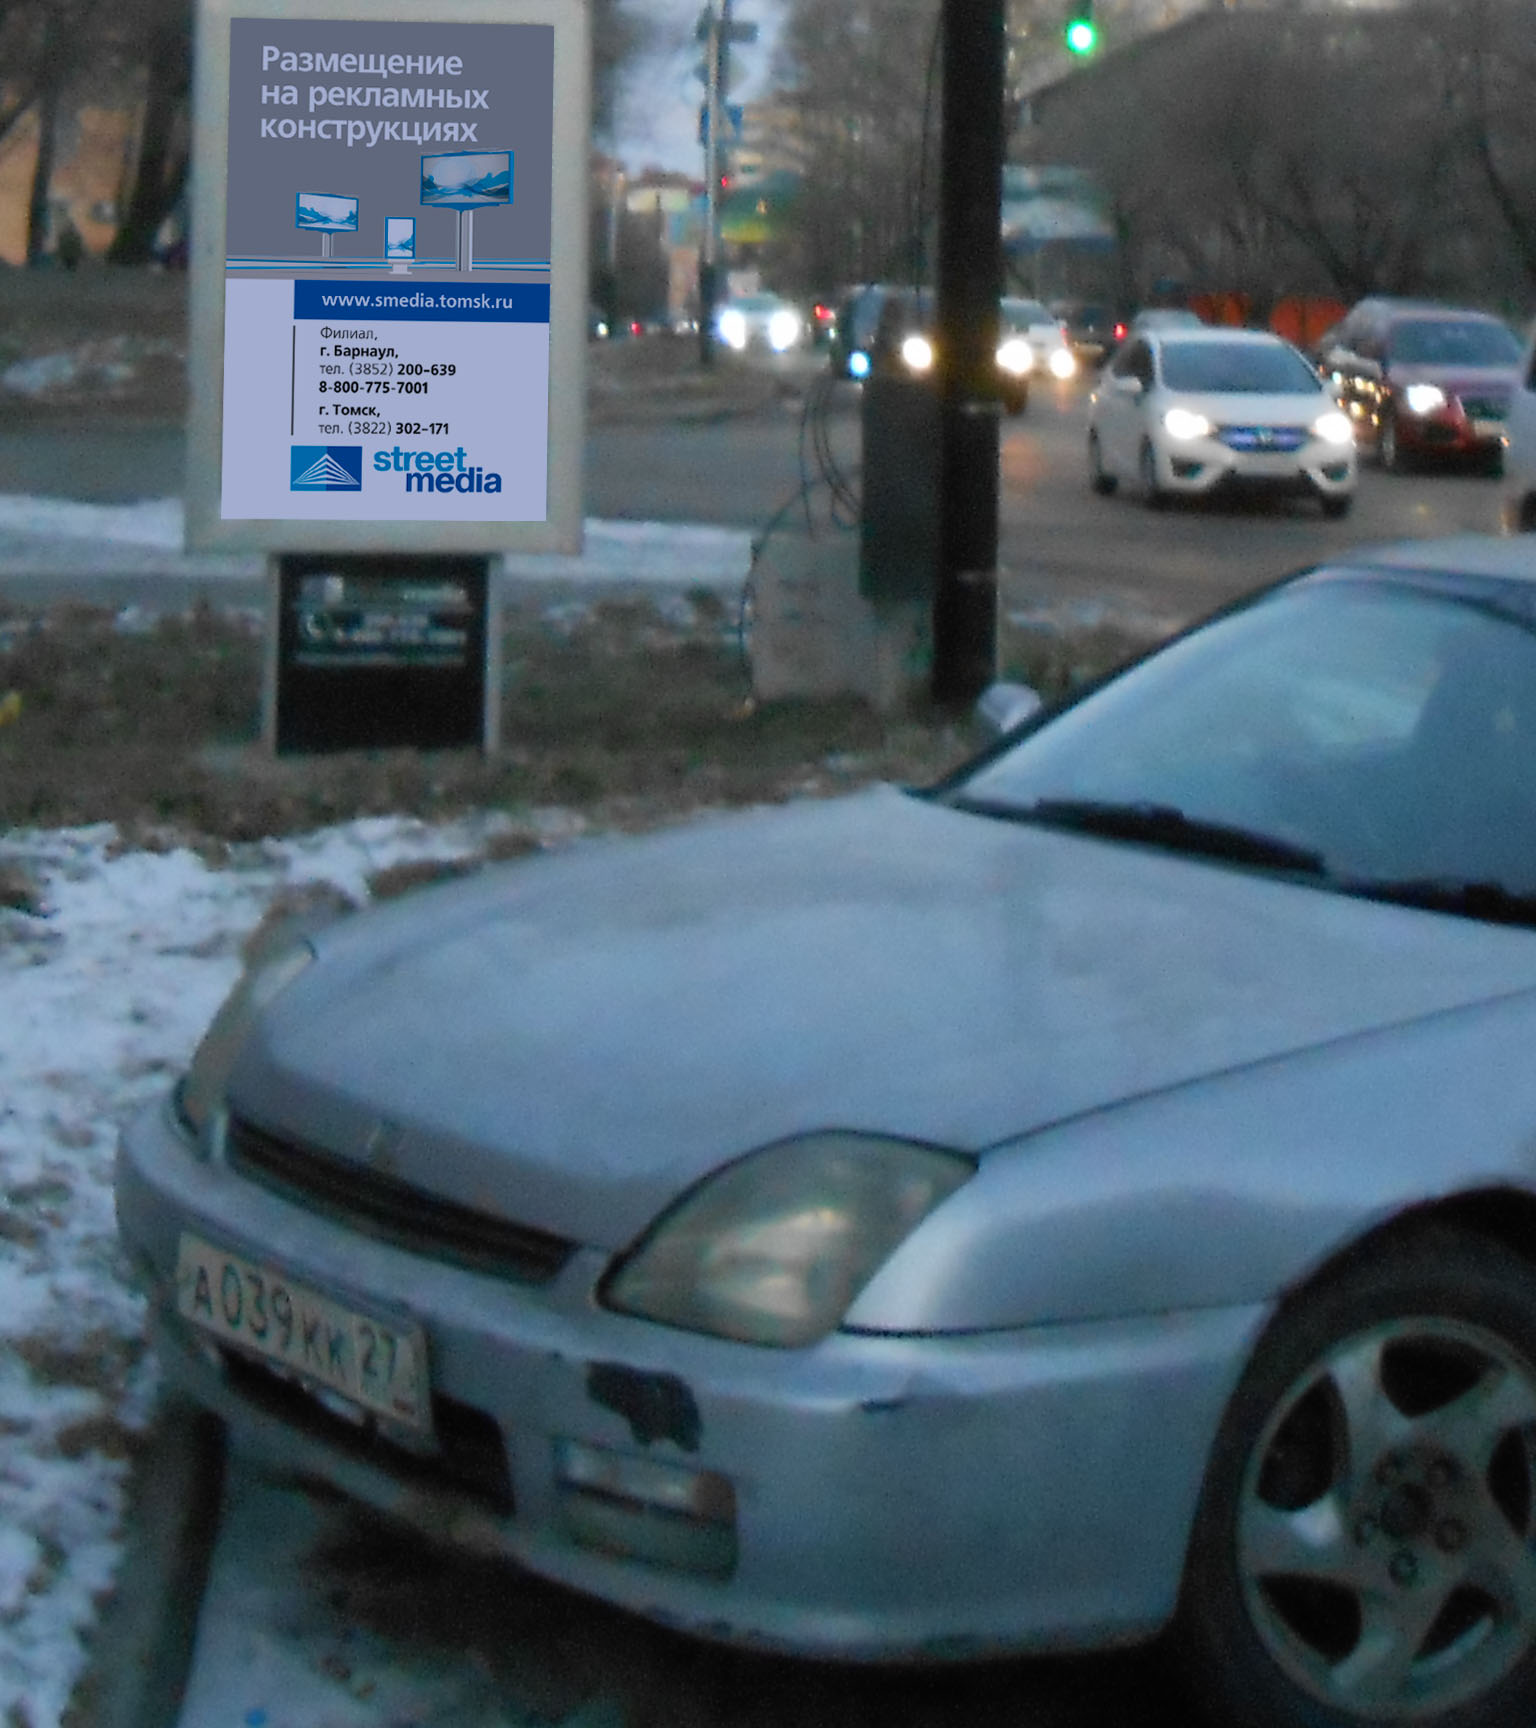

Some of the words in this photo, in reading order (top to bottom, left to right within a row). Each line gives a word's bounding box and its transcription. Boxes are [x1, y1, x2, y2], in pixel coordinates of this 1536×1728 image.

[261, 44, 464, 79] Размещение
[260, 84, 299, 105] на
[308, 85, 490, 113] рекламных
[260, 117, 479, 148] конструкциях
[321, 292, 513, 310] www.smedia.tomsk.ru
[320, 326, 378, 341] Филиал,
[320, 346, 330, 357] г.
[334, 345, 399, 360] Барнаул,
[319, 364, 345, 375] тел.
[349, 362, 394, 377] (3852)
[397, 363, 456, 376] 200-639
[319, 381, 429, 394] 8-800-775-7001
[318, 405, 329, 416] г.
[332, 404, 381, 418] Томск,
[318, 423, 344, 435] тел.
[348, 421, 392, 436] (3822)
[395, 423, 449, 435] 302-171
[373, 446, 468, 473] street
[405, 467, 503, 494] media
